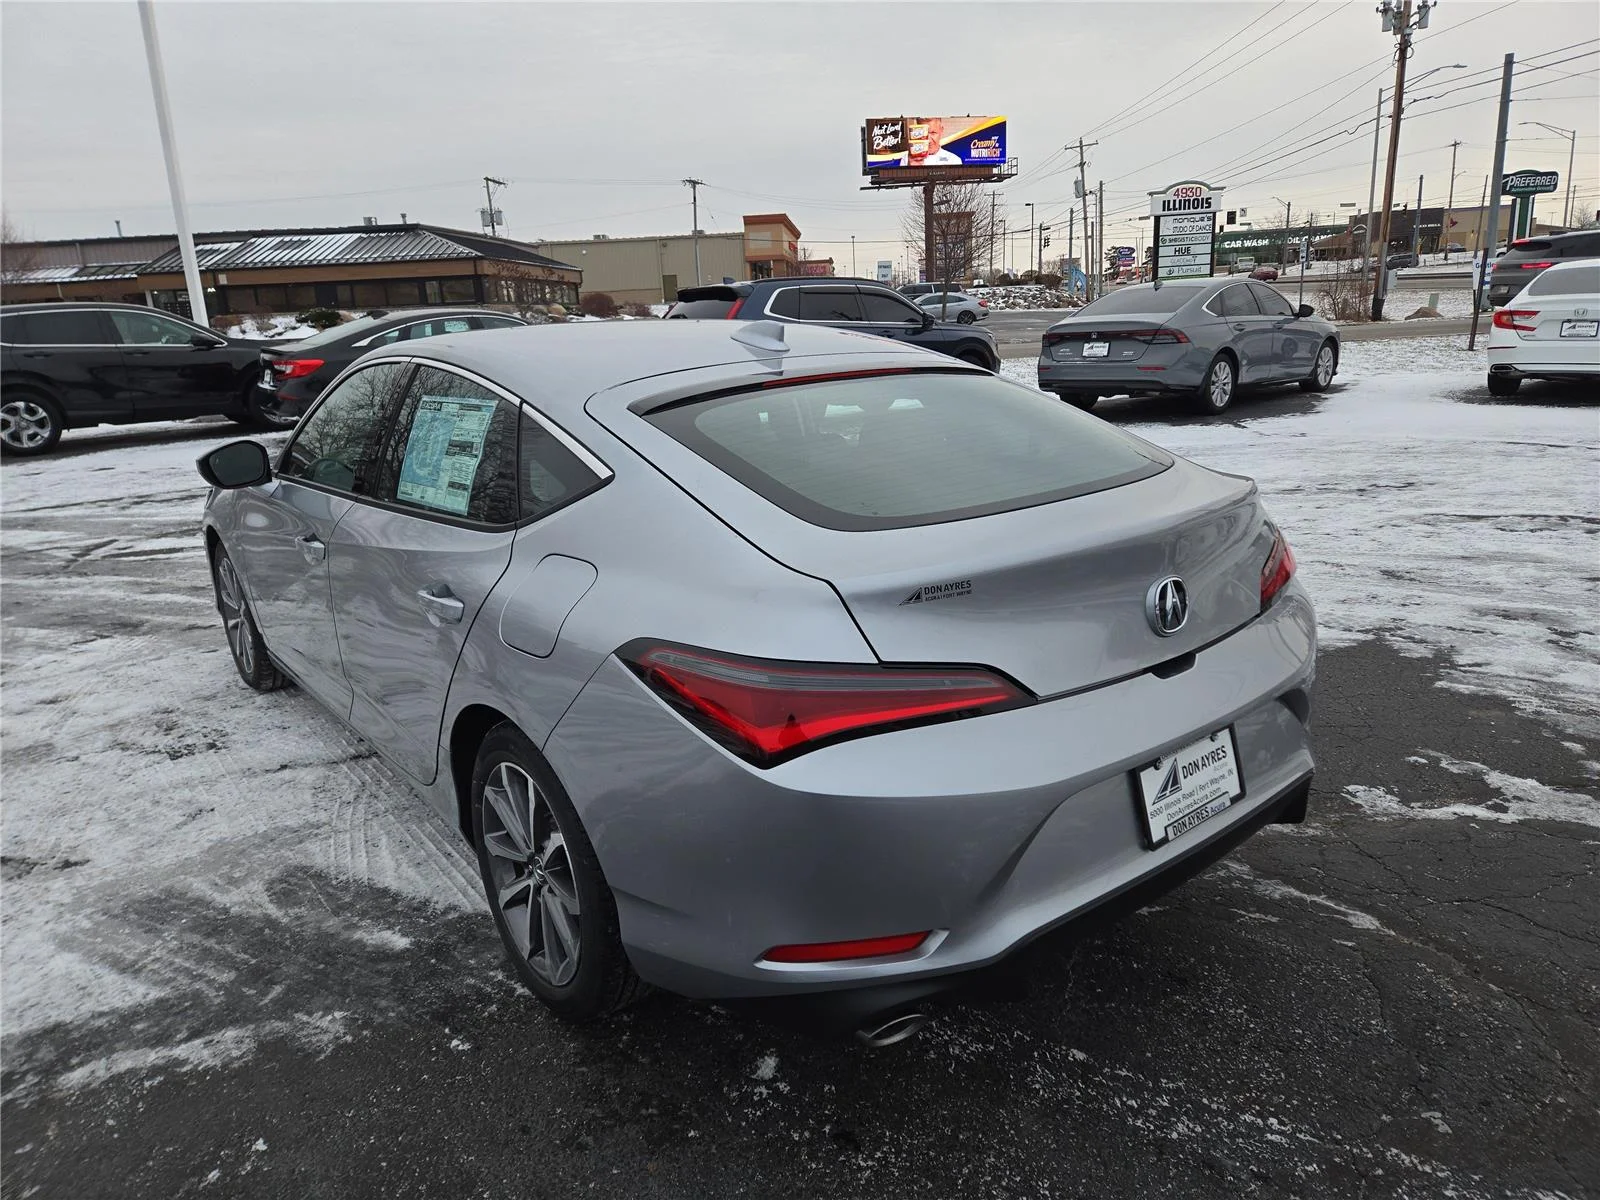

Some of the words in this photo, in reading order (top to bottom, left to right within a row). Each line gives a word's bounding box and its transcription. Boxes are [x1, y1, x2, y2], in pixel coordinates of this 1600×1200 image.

[1506, 175, 1558, 190] PREFERRED
[1173, 186, 1202, 199] 4930
[1161, 197, 1212, 212] ILLINOIS
[1172, 226, 1187, 234] STUDIO
[1188, 225, 1195, 233] OF
[1195, 224, 1212, 232] DANCE
[1224, 240, 1242, 249] CAR
[1243, 238, 1269, 248] WASH
[1287, 236, 1300, 245] OIL
[1174, 246, 1192, 255] HUE
[924, 584, 942, 595] DON
[943, 580, 972, 592] AYRES
[1181, 758, 1201, 779] DON
[1201, 745, 1227, 770] AYRES
[1164, 797, 1181, 811] Illinois
[1182, 790, 1196, 802] Road
[1199, 782, 1210, 793] Fort
[1172, 820, 1188, 837] DON
[1188, 806, 1210, 828] AYRES
[1210, 801, 1226, 815] Acura
